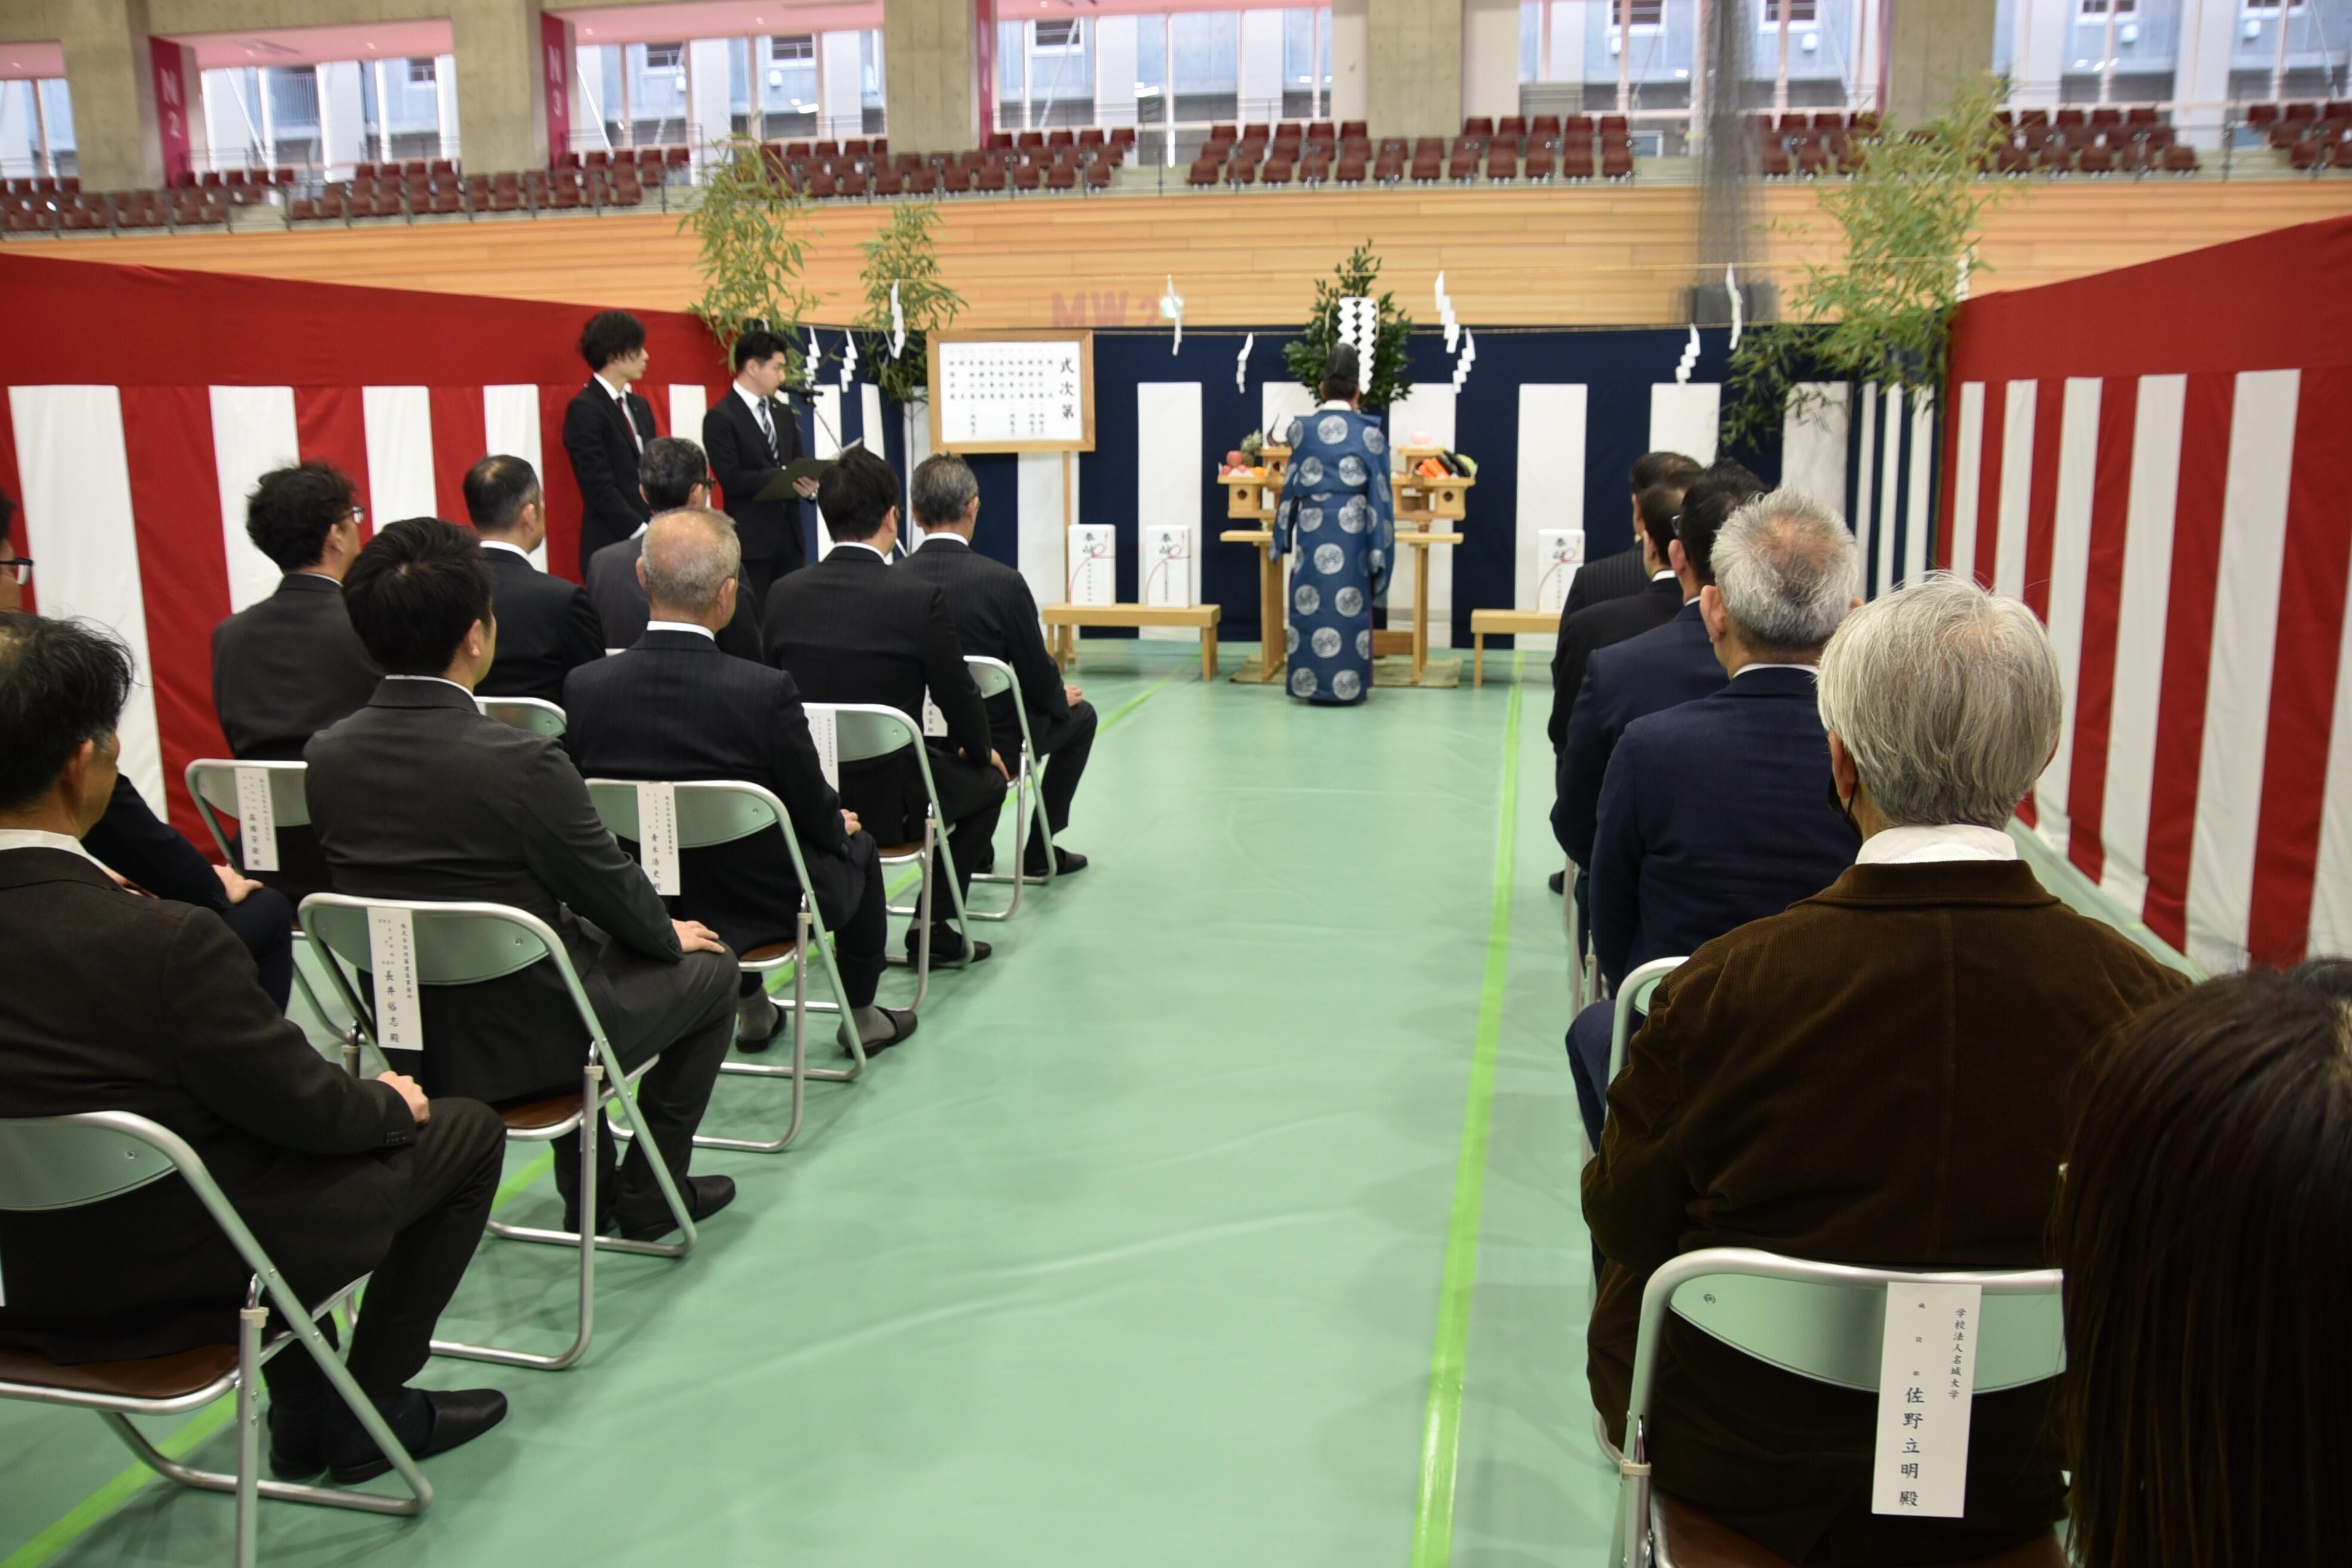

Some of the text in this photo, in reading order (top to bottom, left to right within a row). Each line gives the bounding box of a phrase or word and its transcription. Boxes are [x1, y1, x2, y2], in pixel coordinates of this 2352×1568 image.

[1059, 357, 1074, 419] 式次第
[1948, 1307, 1967, 1399] 学校法人名城大学
[1898, 1386, 1925, 1506] 佐野立明殿
